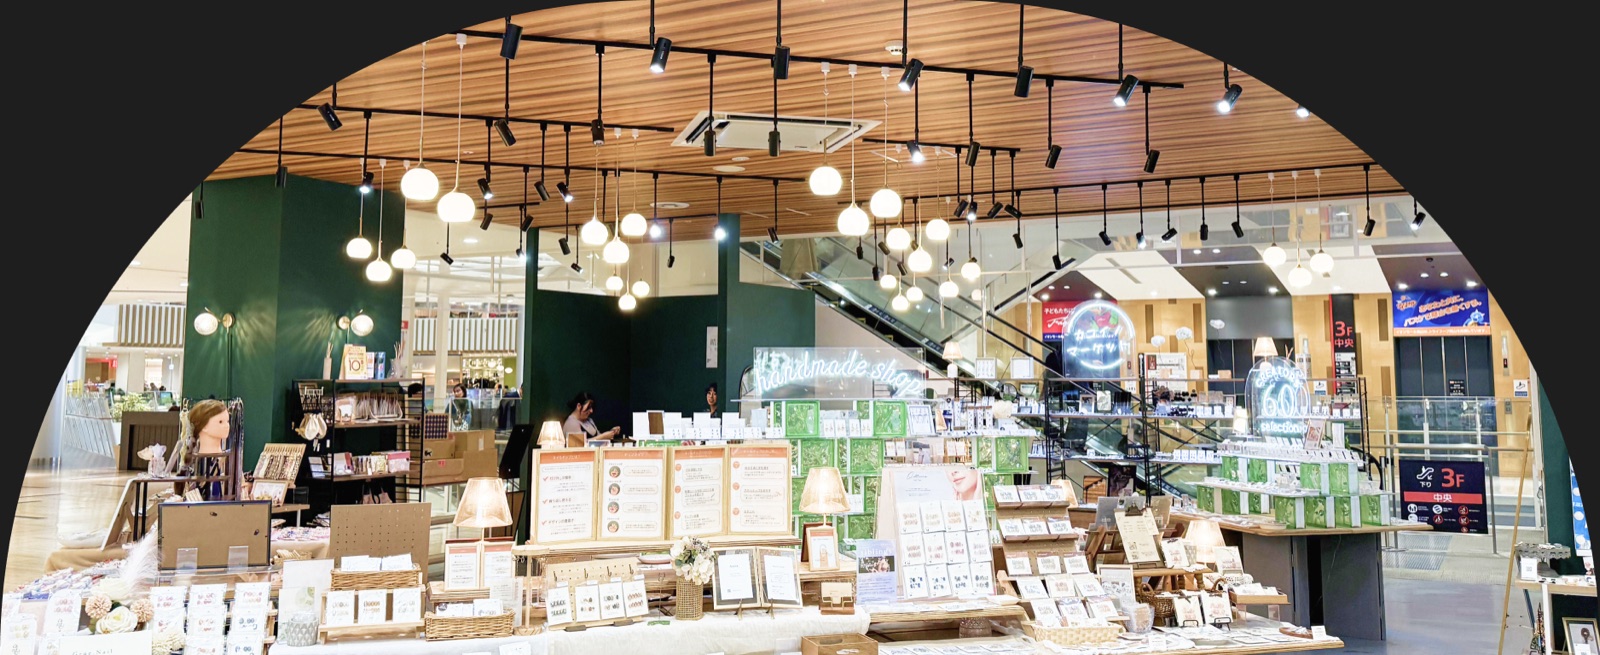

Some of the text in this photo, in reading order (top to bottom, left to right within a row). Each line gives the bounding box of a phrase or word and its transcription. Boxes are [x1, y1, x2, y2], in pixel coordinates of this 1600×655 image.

[1335, 321, 1353, 337] 3F
[1335, 338, 1354, 348] 中央
[755, 349, 923, 398] handmade shop
[1441, 467, 1465, 488] 3F
[1433, 492, 1453, 503] 中央
